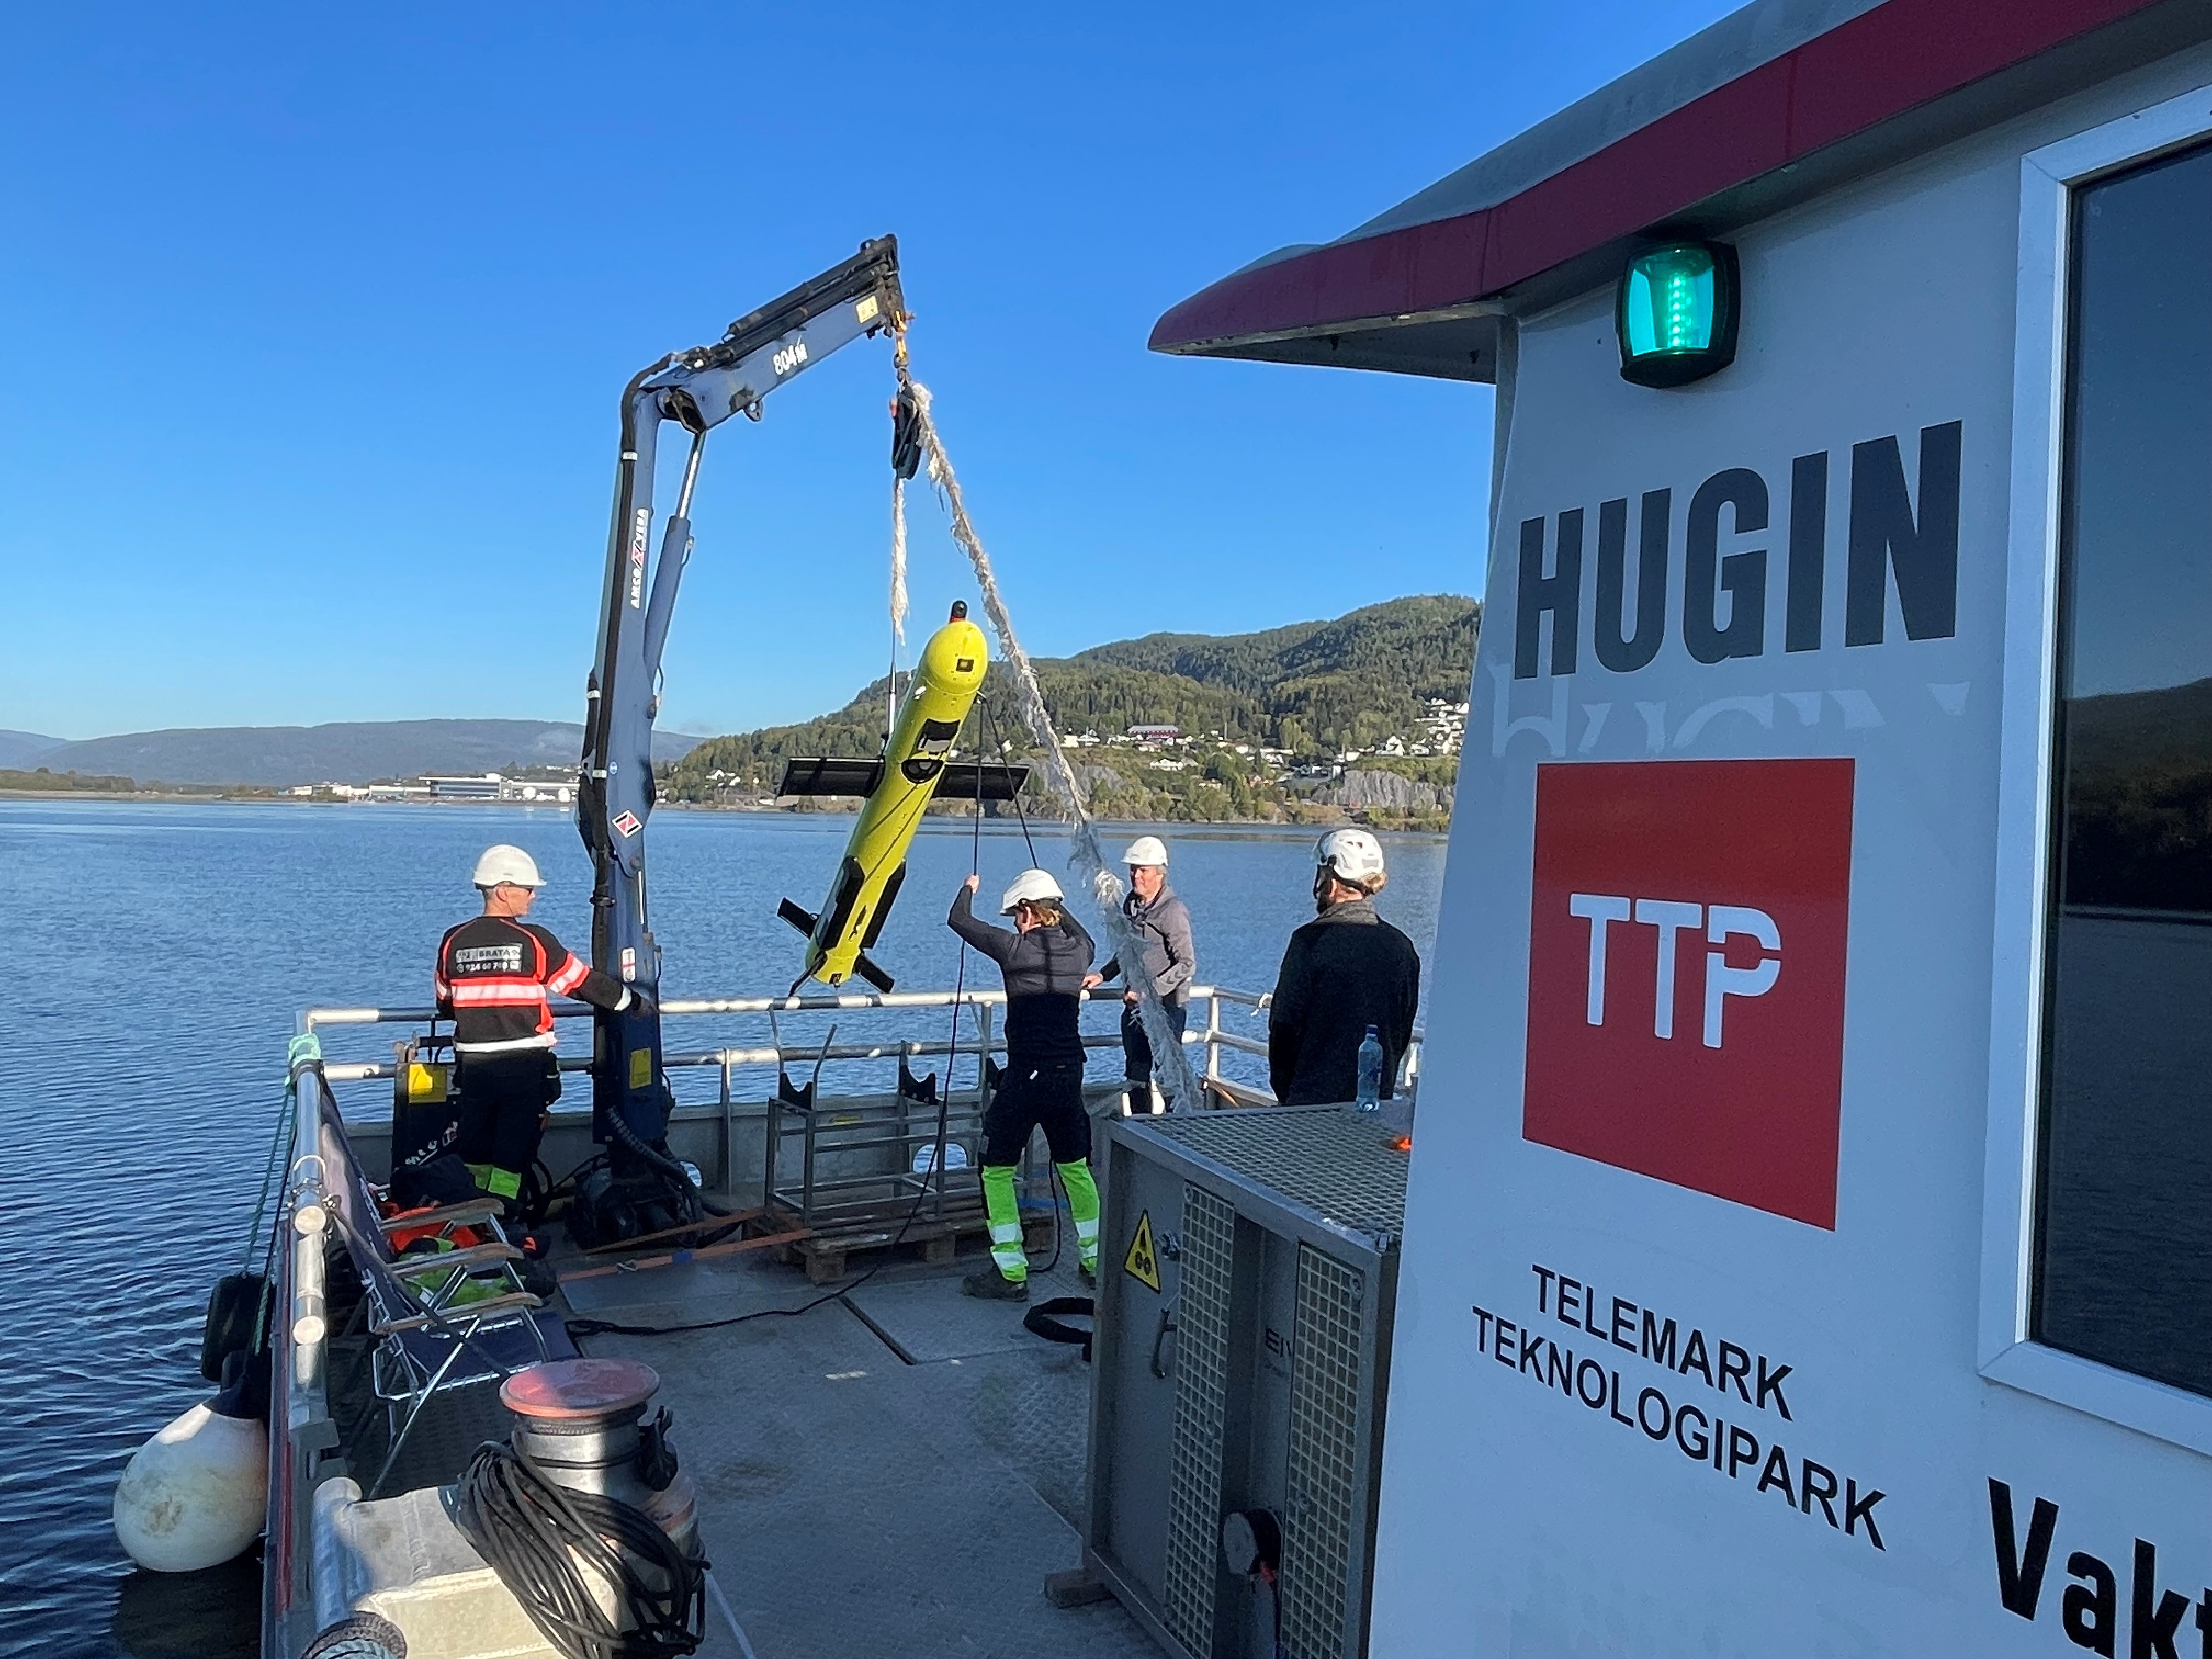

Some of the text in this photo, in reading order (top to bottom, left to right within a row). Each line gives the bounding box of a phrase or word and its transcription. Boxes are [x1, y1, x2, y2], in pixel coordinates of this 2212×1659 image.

[630, 567, 642, 609] AMCO
[1514, 419, 1963, 680] HUGIN
[1570, 893, 1782, 1049] TTP
[1532, 1263, 1793, 1422] TELEMARK
[1472, 1306, 1886, 1551] TEKNOLOGIPARK
